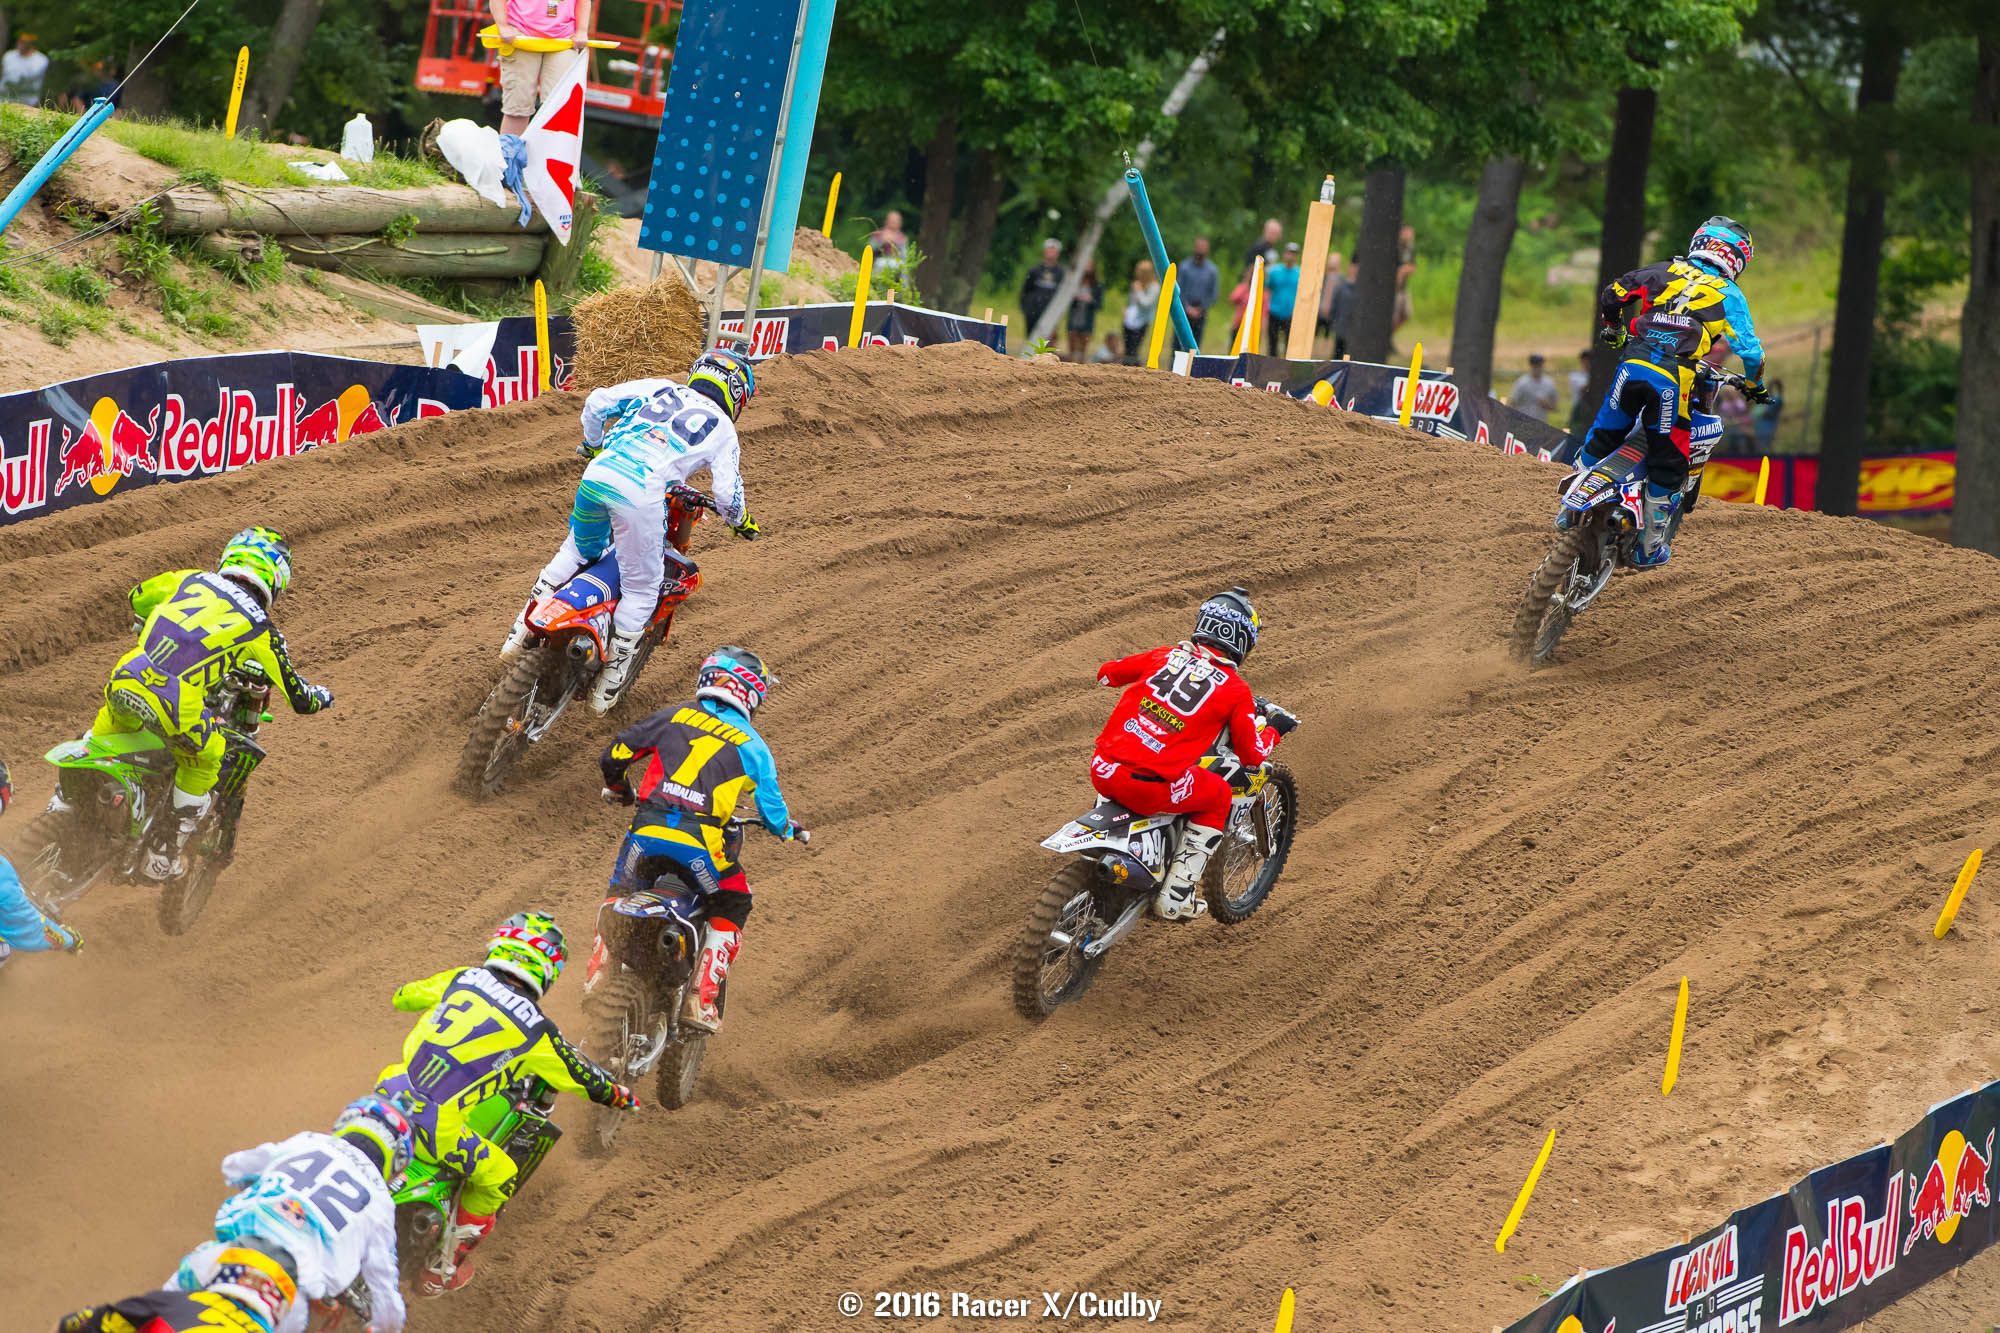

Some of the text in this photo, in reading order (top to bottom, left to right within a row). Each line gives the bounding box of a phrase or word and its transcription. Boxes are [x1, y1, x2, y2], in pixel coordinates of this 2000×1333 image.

[715, 320, 762, 357] LUS
[762, 320, 785, 356] OIL
[1396, 380, 1440, 415] LCAS
[1611, 366, 1630, 402] YAMAHA
[638, 386, 719, 447] 30
[1660, 399, 1674, 433] YAMAHA
[0, 418, 52, 514] ull
[1590, 487, 1615, 507] DUNLOP
[159, 583, 253, 650] 24
[1147, 668, 1215, 716] 49
[670, 707, 752, 746] MARTIN
[670, 735, 727, 787] 1
[662, 781, 706, 806] YAMALUBE
[1141, 828, 1162, 867] 49
[457, 966, 545, 1029] SAVATGY
[432, 989, 528, 1064] 37
[553, 1036, 601, 1087] ENERGY
[273, 1149, 371, 1233] 42
[1694, 1296, 1715, 1320] RO
